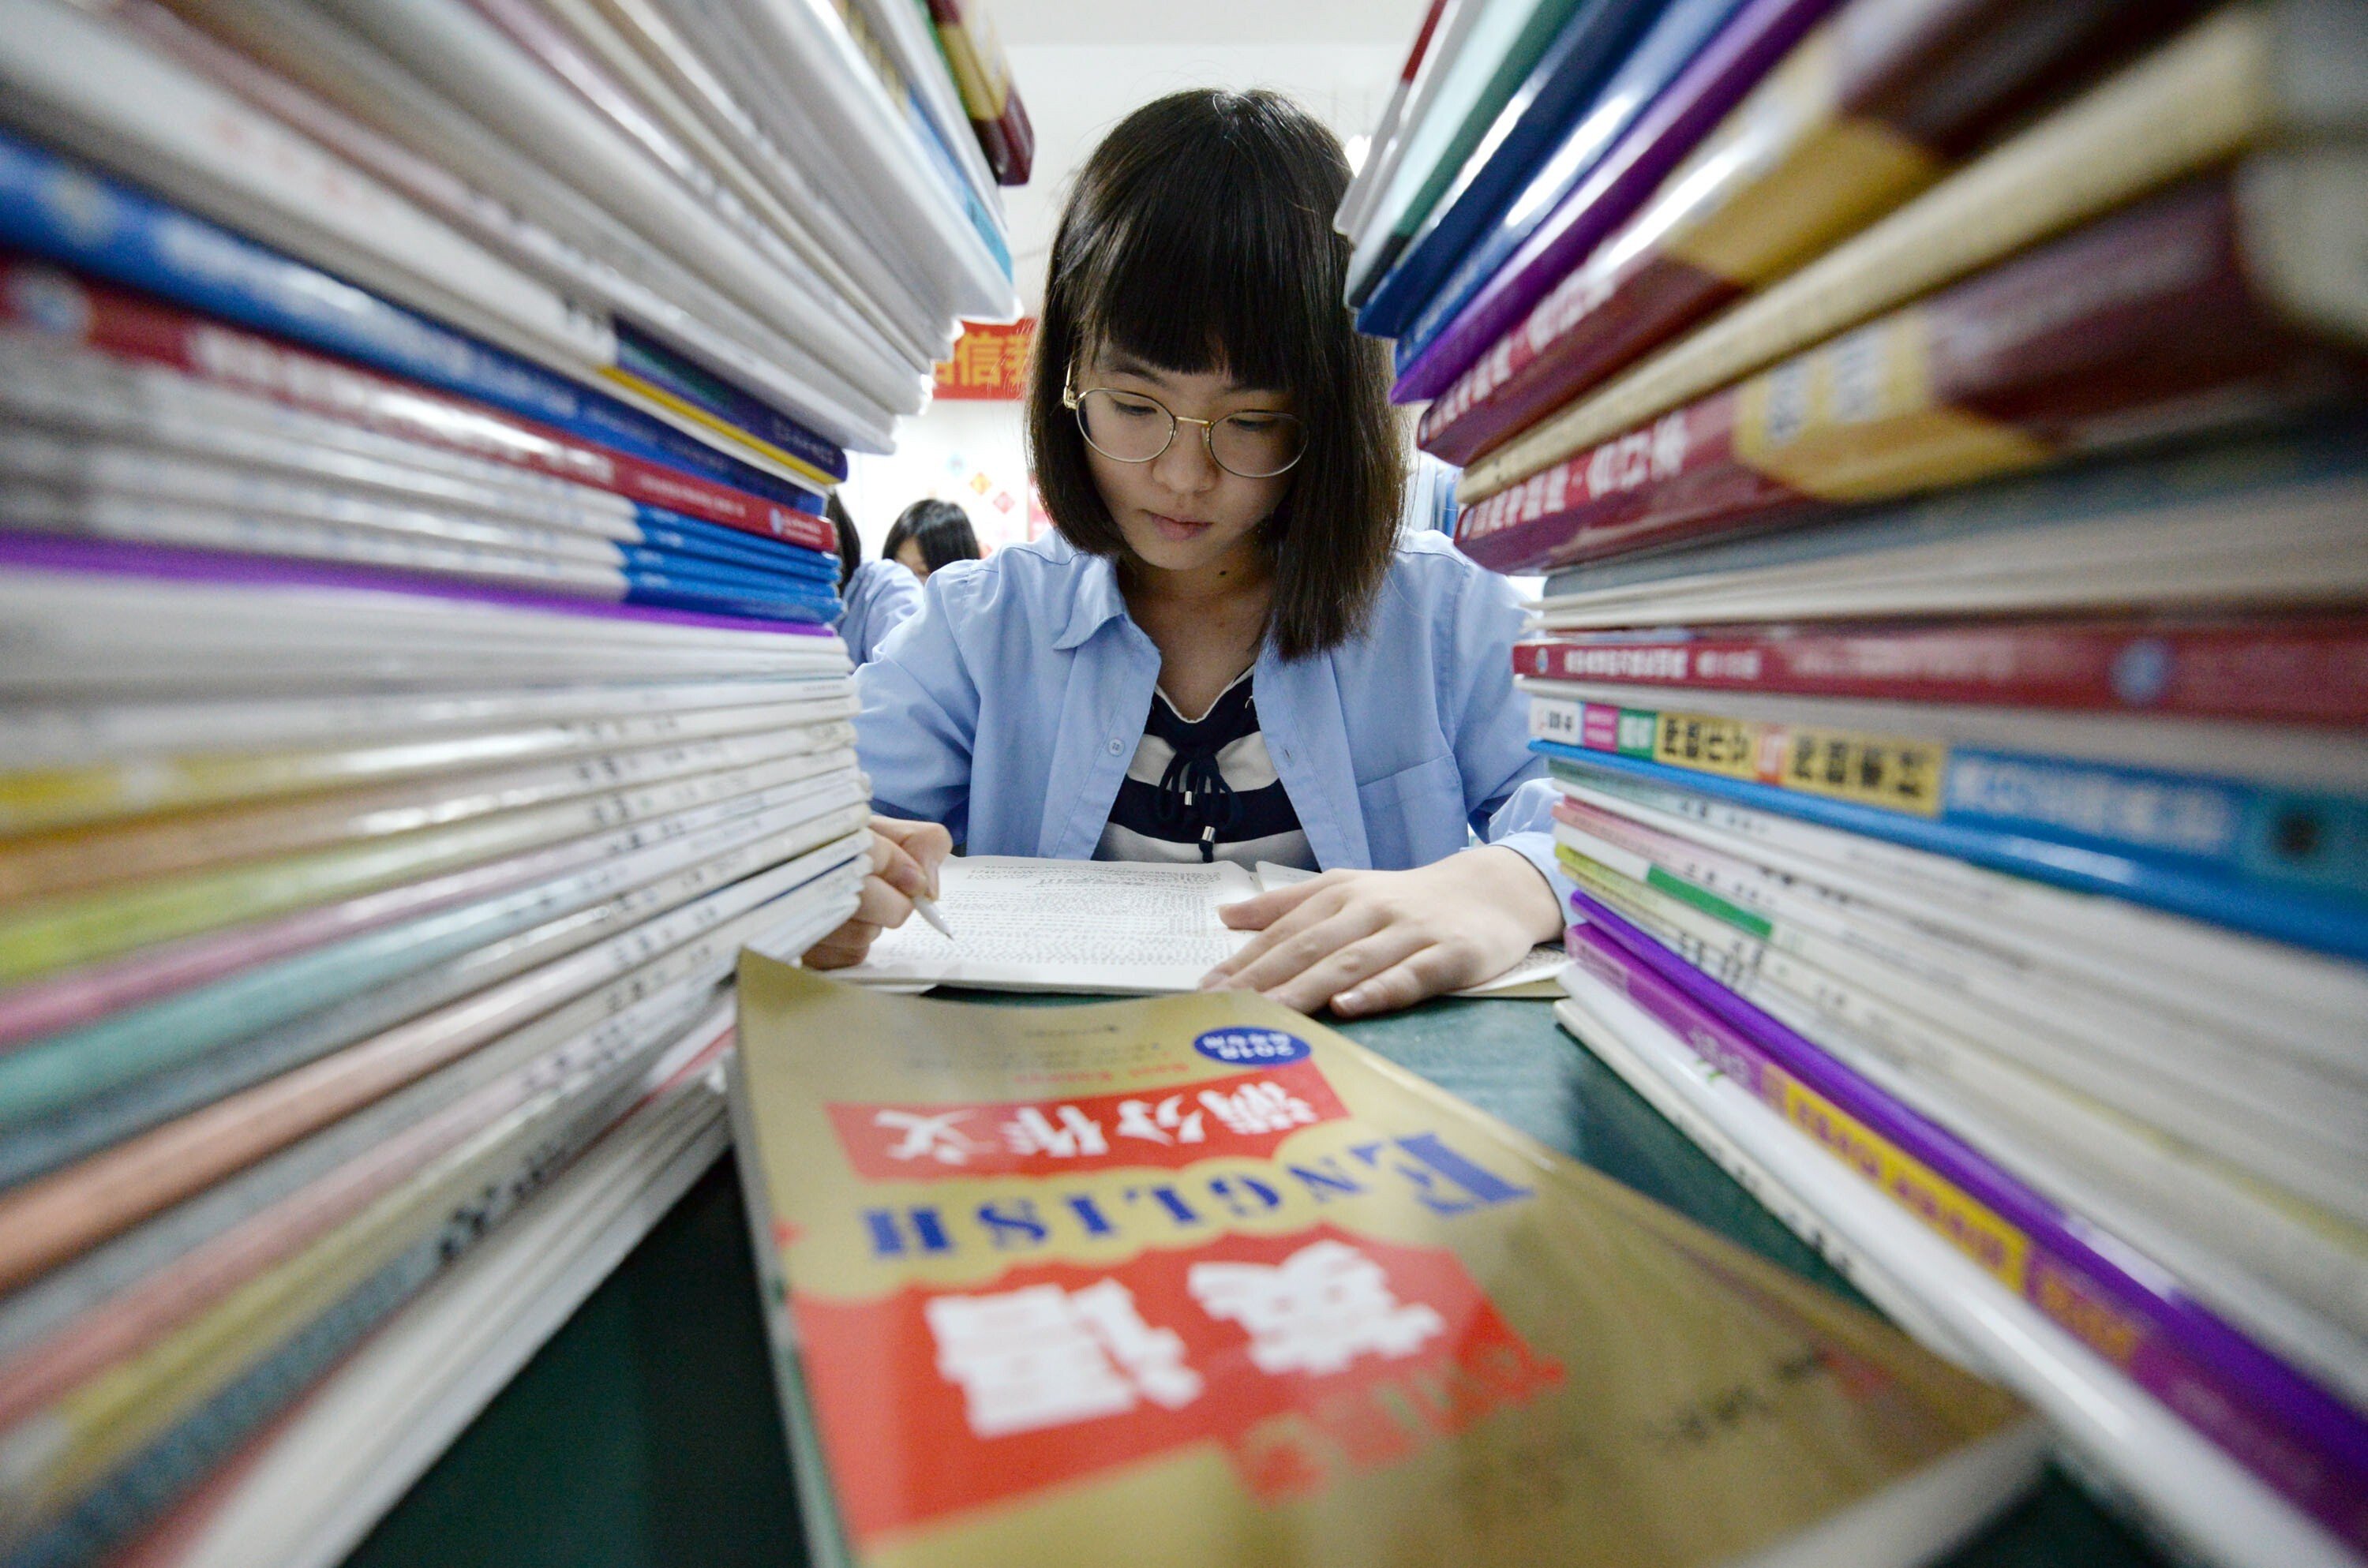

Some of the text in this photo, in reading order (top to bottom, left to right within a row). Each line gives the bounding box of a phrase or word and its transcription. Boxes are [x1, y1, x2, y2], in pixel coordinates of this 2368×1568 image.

[1218, 1043, 1295, 1060] 2018
[875, 1080, 1317, 1165] 满分作文
[863, 1132, 1534, 1259] ENGLISH
[924, 1237, 1444, 1439] 英语
